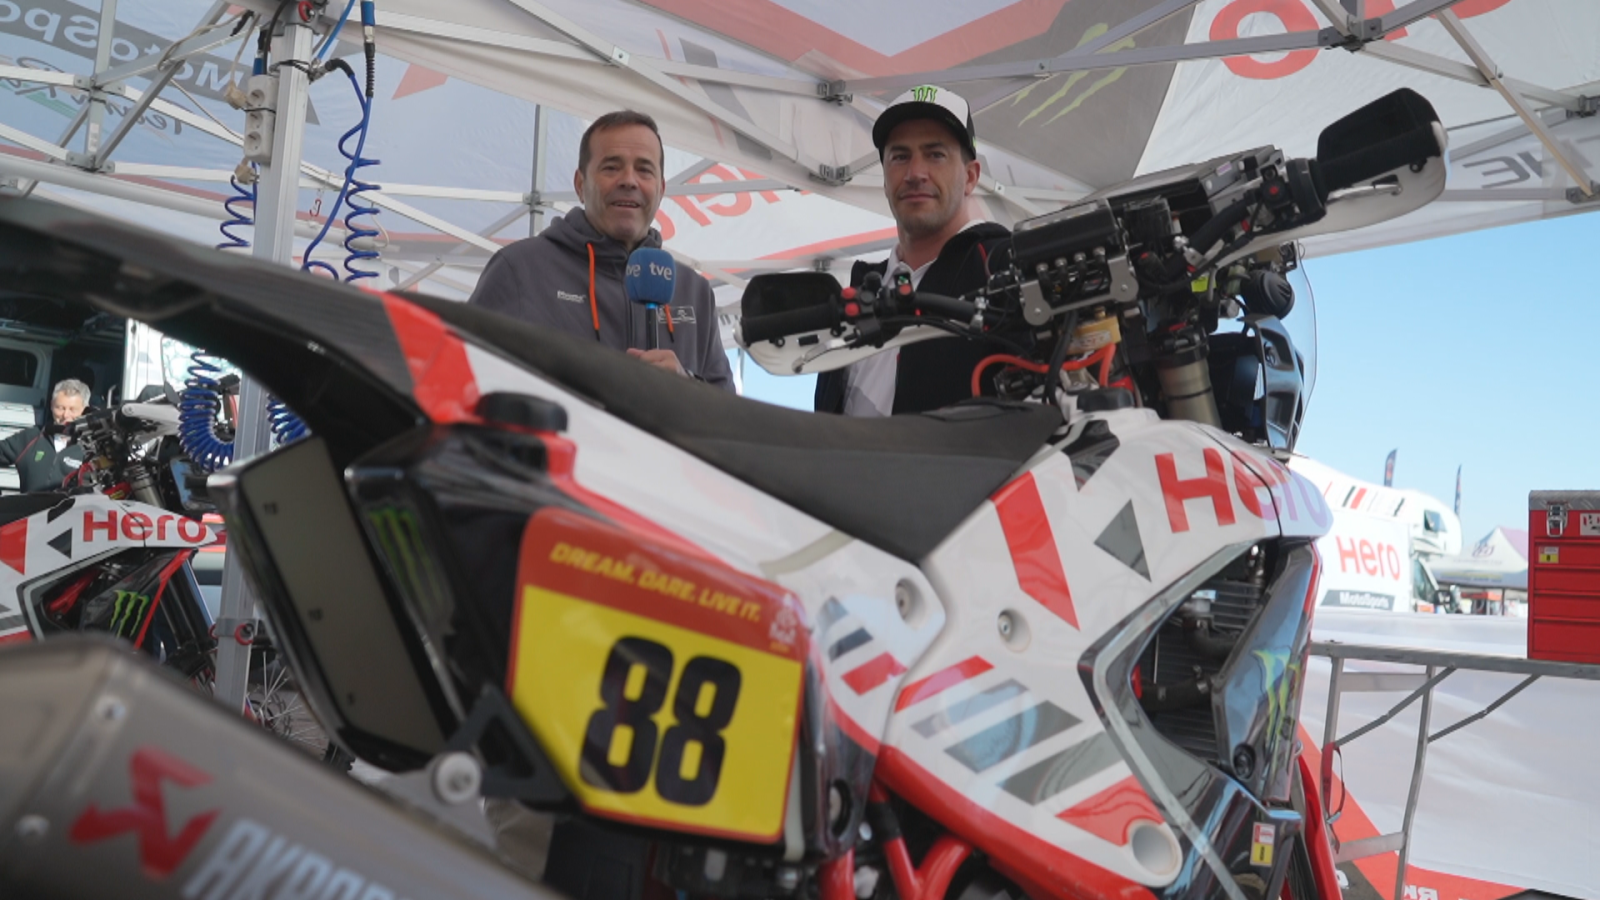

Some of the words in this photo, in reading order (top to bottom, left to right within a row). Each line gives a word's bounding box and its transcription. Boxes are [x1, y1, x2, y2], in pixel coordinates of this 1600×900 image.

[649, 262, 672, 281] tve
[83, 509, 207, 543] Hero
[1335, 534, 1401, 581] Hero
[550, 541, 635, 584] DREAM.
[637, 569, 696, 604] DARE.
[697, 587, 738, 617] LIVE
[737, 600, 762, 623] IT.
[580, 637, 742, 806] 88
